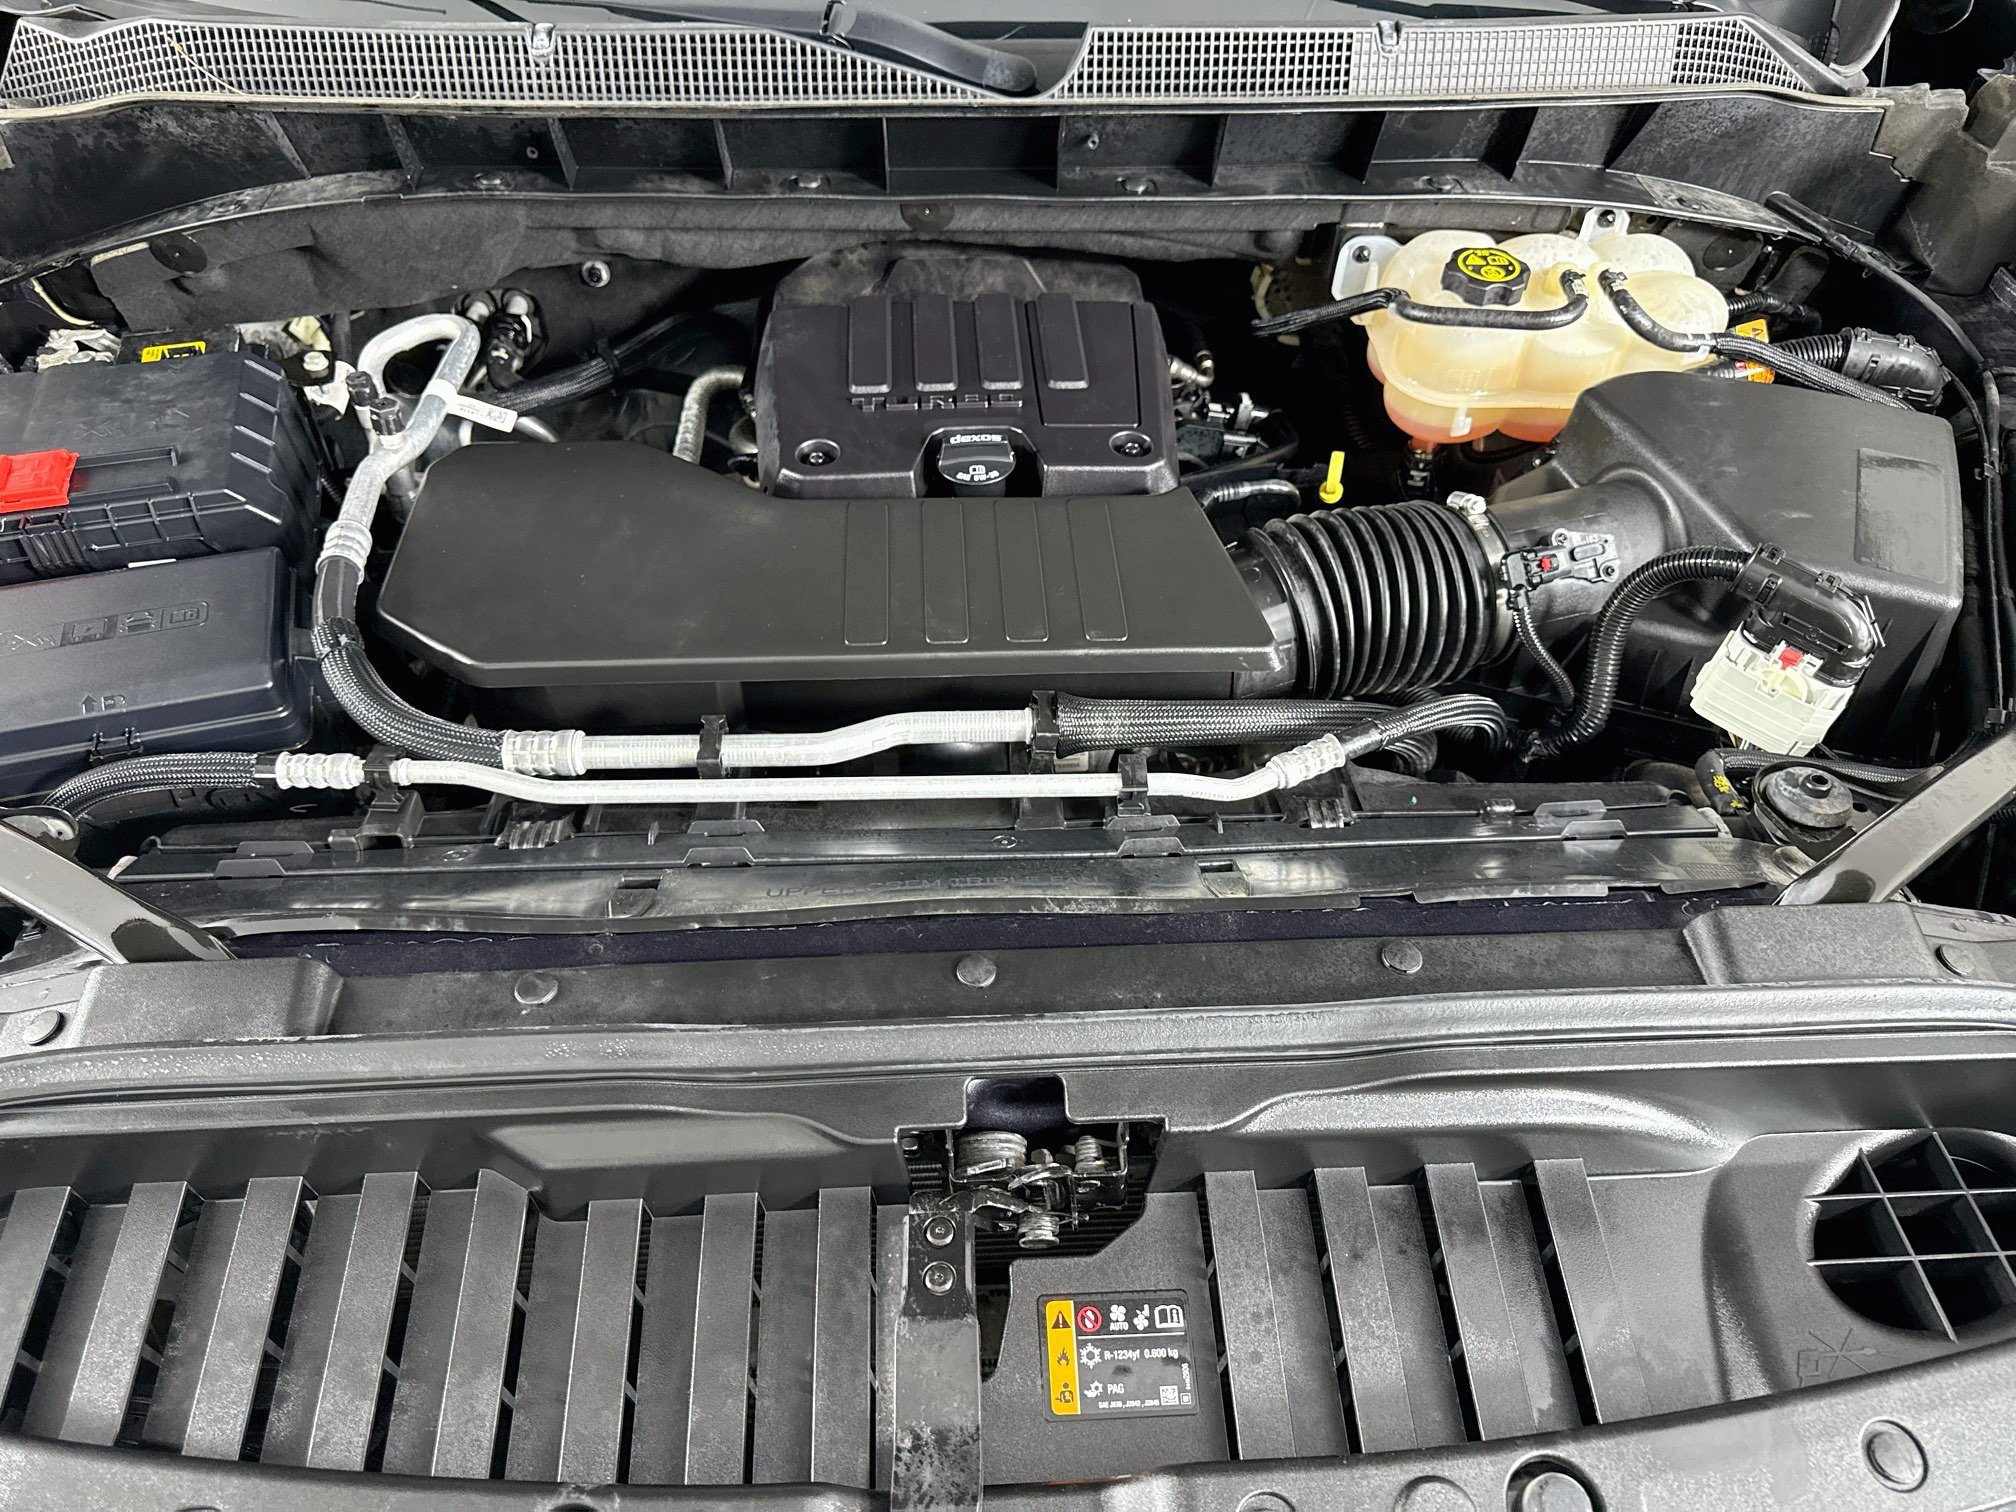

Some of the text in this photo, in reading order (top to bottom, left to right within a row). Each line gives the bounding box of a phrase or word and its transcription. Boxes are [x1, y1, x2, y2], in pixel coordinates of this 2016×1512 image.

[950, 434, 1003, 444] dexos
[1110, 1321, 1129, 1331] AUTO
[1104, 1349, 1140, 1361] R-1234yf
[1168, 1347, 1179, 1359] kg
[1107, 1383, 1125, 1395] PAG
